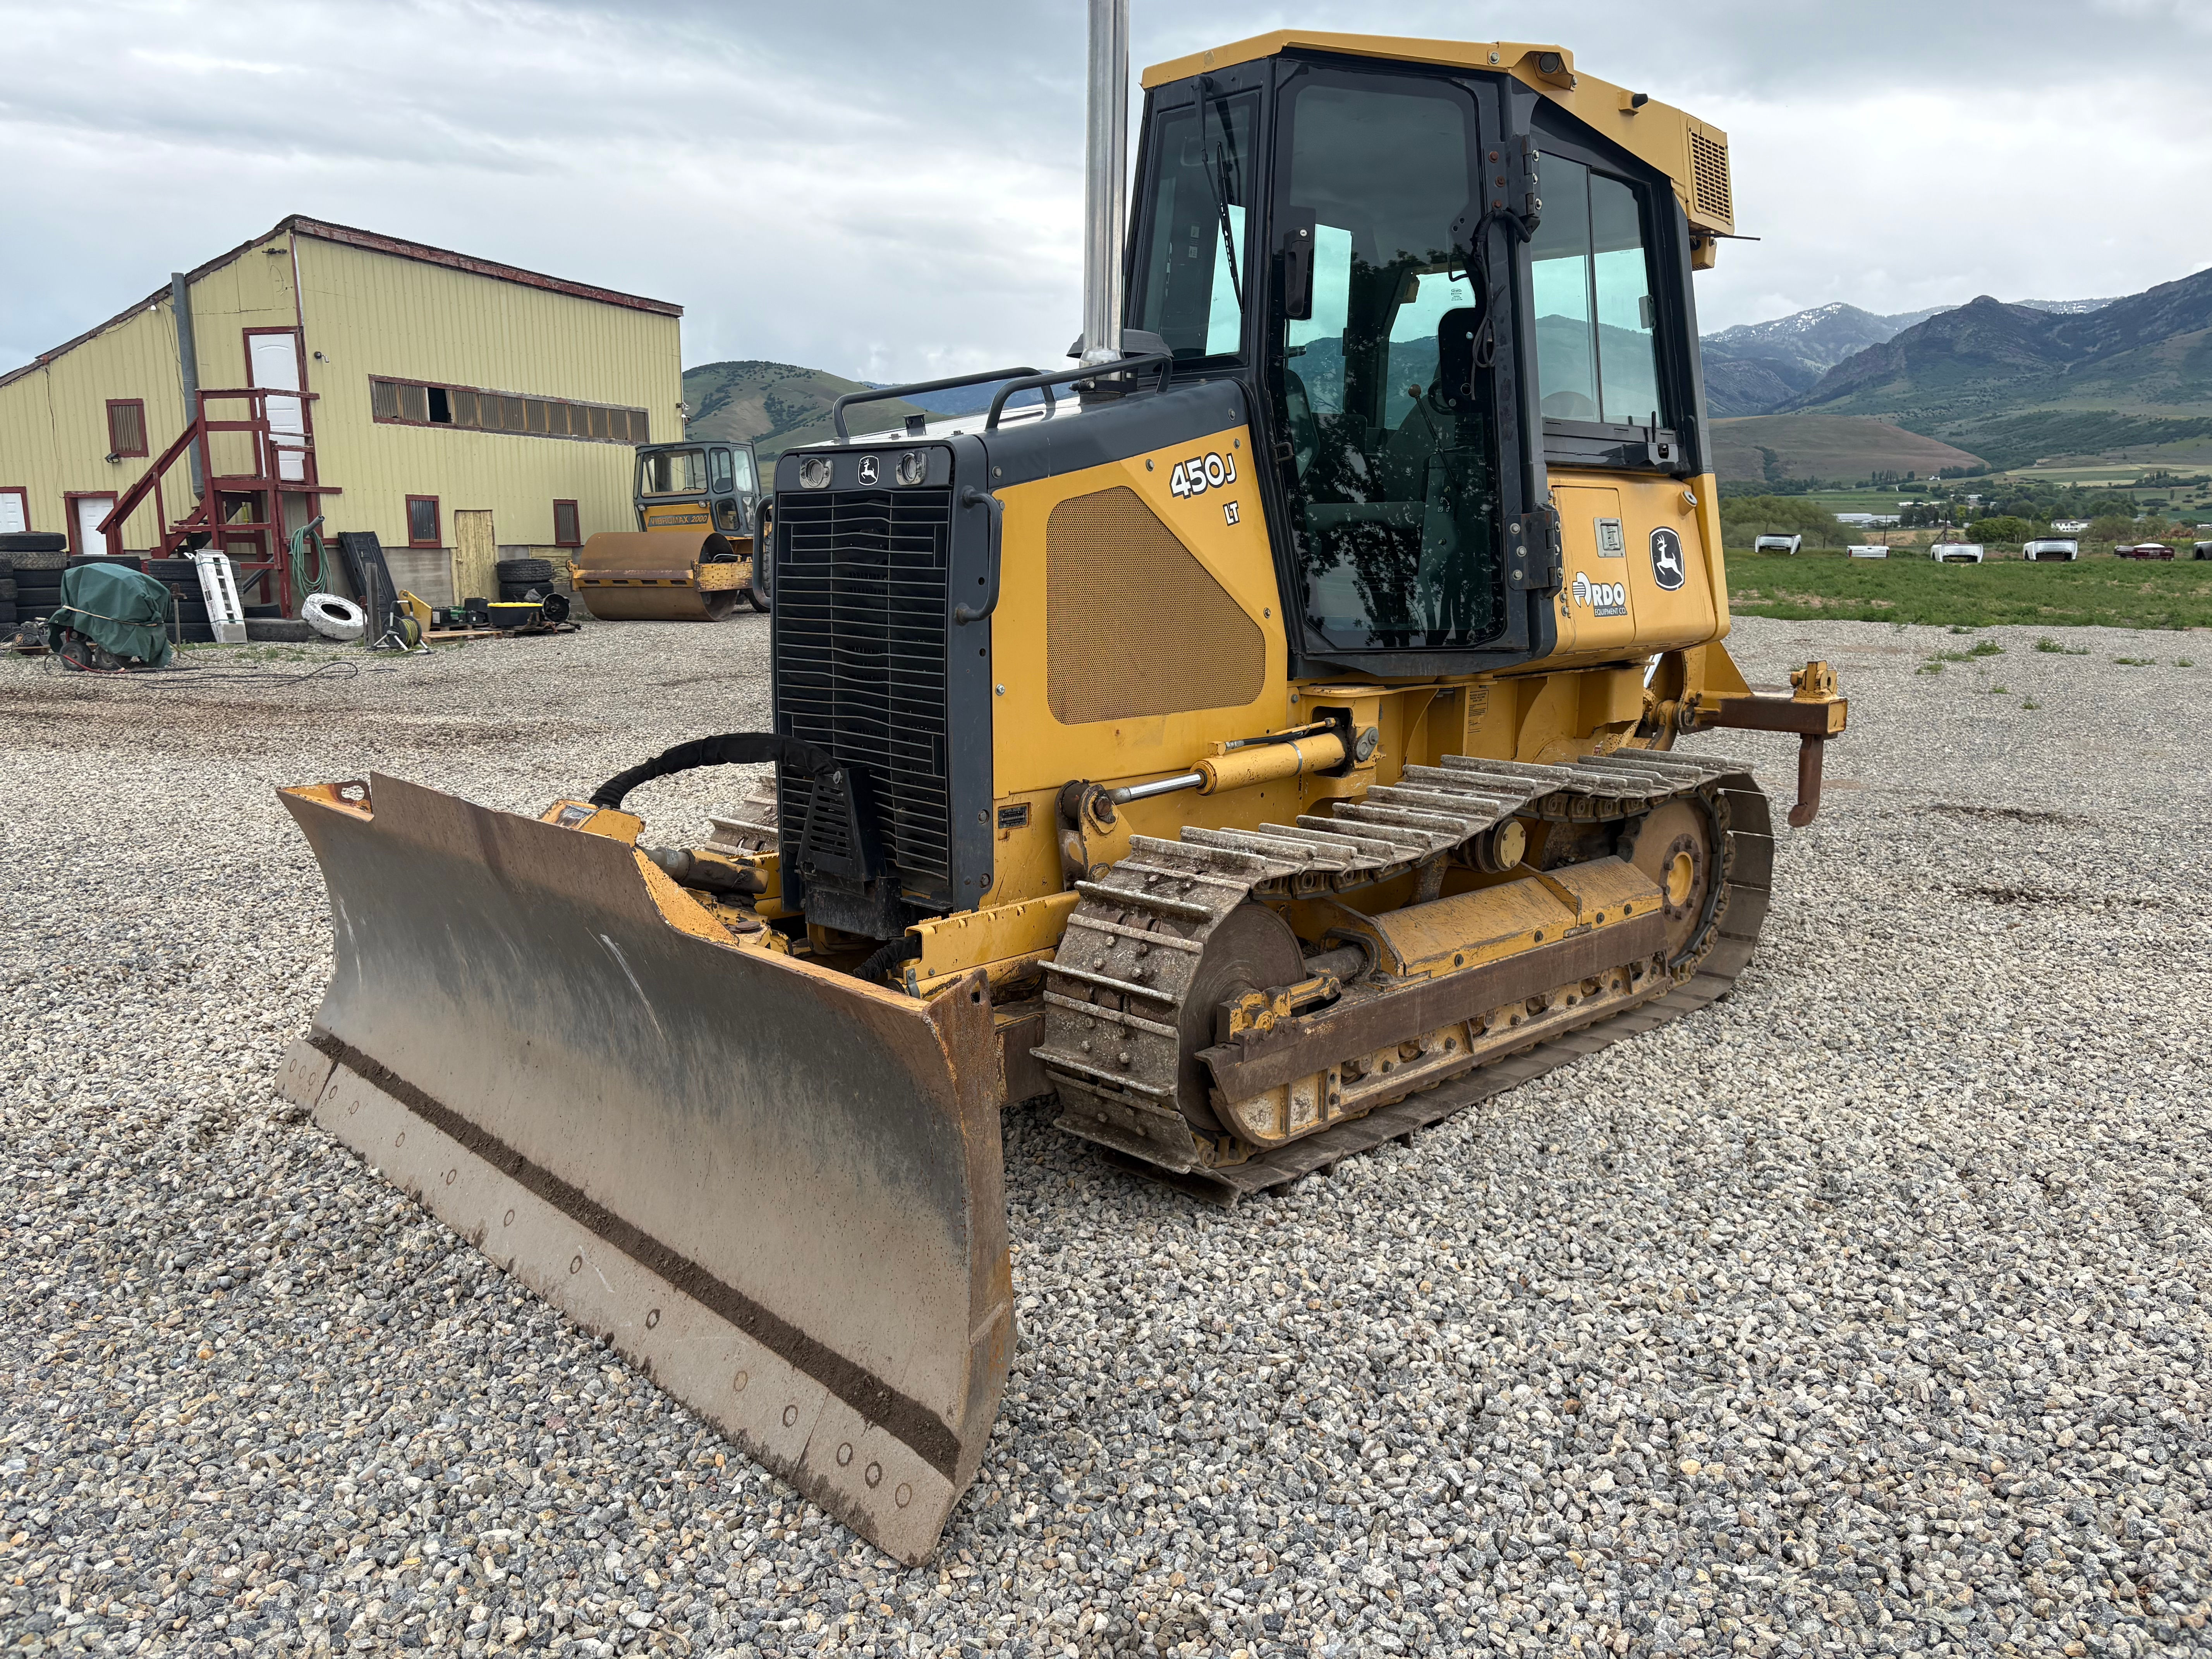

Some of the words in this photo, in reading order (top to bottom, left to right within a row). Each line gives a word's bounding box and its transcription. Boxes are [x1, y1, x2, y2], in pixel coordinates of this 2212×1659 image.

[1170, 452, 1237, 499] 450J
[651, 516, 689, 524] VIBROMAX
[1223, 500, 1240, 526] LT
